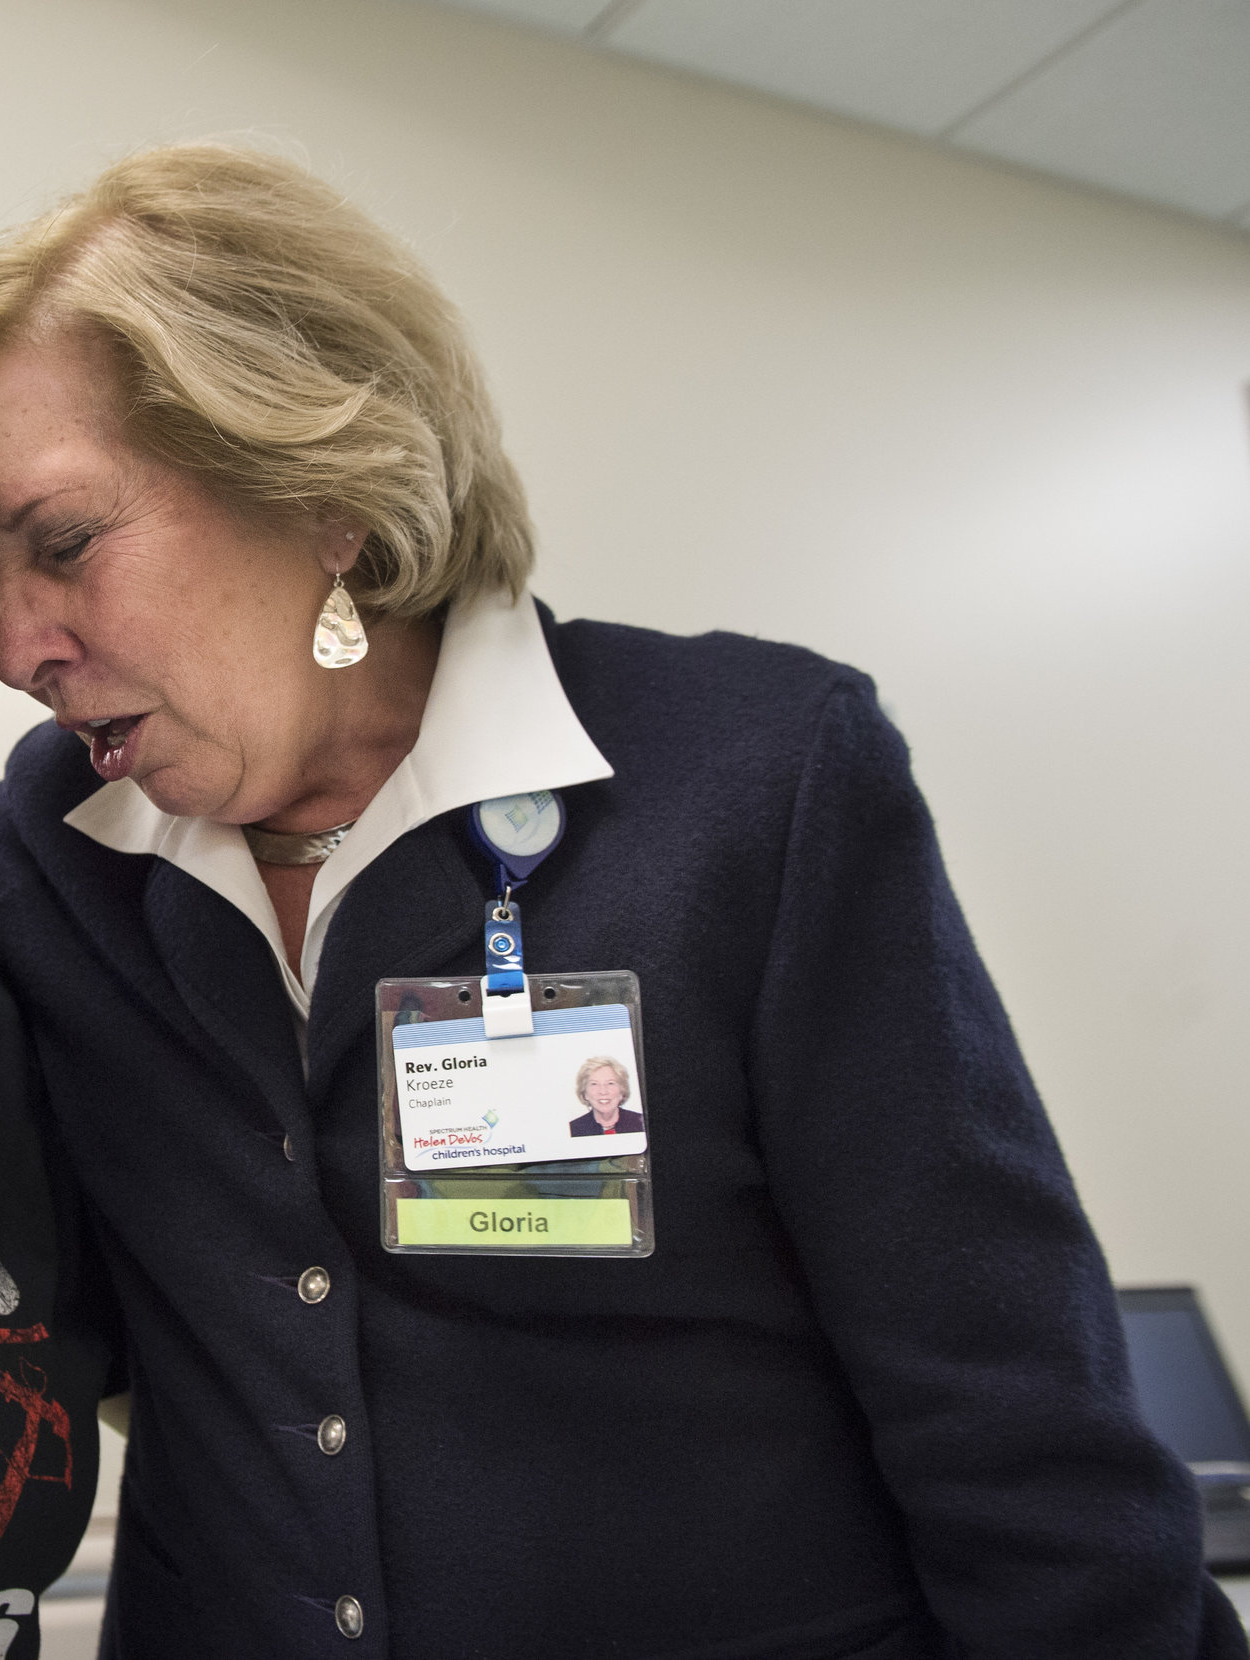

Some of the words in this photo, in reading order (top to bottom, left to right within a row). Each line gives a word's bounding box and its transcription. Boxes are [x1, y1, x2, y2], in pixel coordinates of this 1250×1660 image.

[405, 1061, 438, 1074] Rev.
[441, 1056, 488, 1071] Gloria
[406, 1078, 454, 1092] Kroeze
[408, 1097, 452, 1109] Chaplain
[429, 1127, 463, 1135] SPECTRUM
[413, 1135, 447, 1149] Helen
[447, 1132, 484, 1146] DeVos
[431, 1147, 482, 1160] children's
[482, 1143, 527, 1157] hospital
[469, 1210, 549, 1233] Gloria
